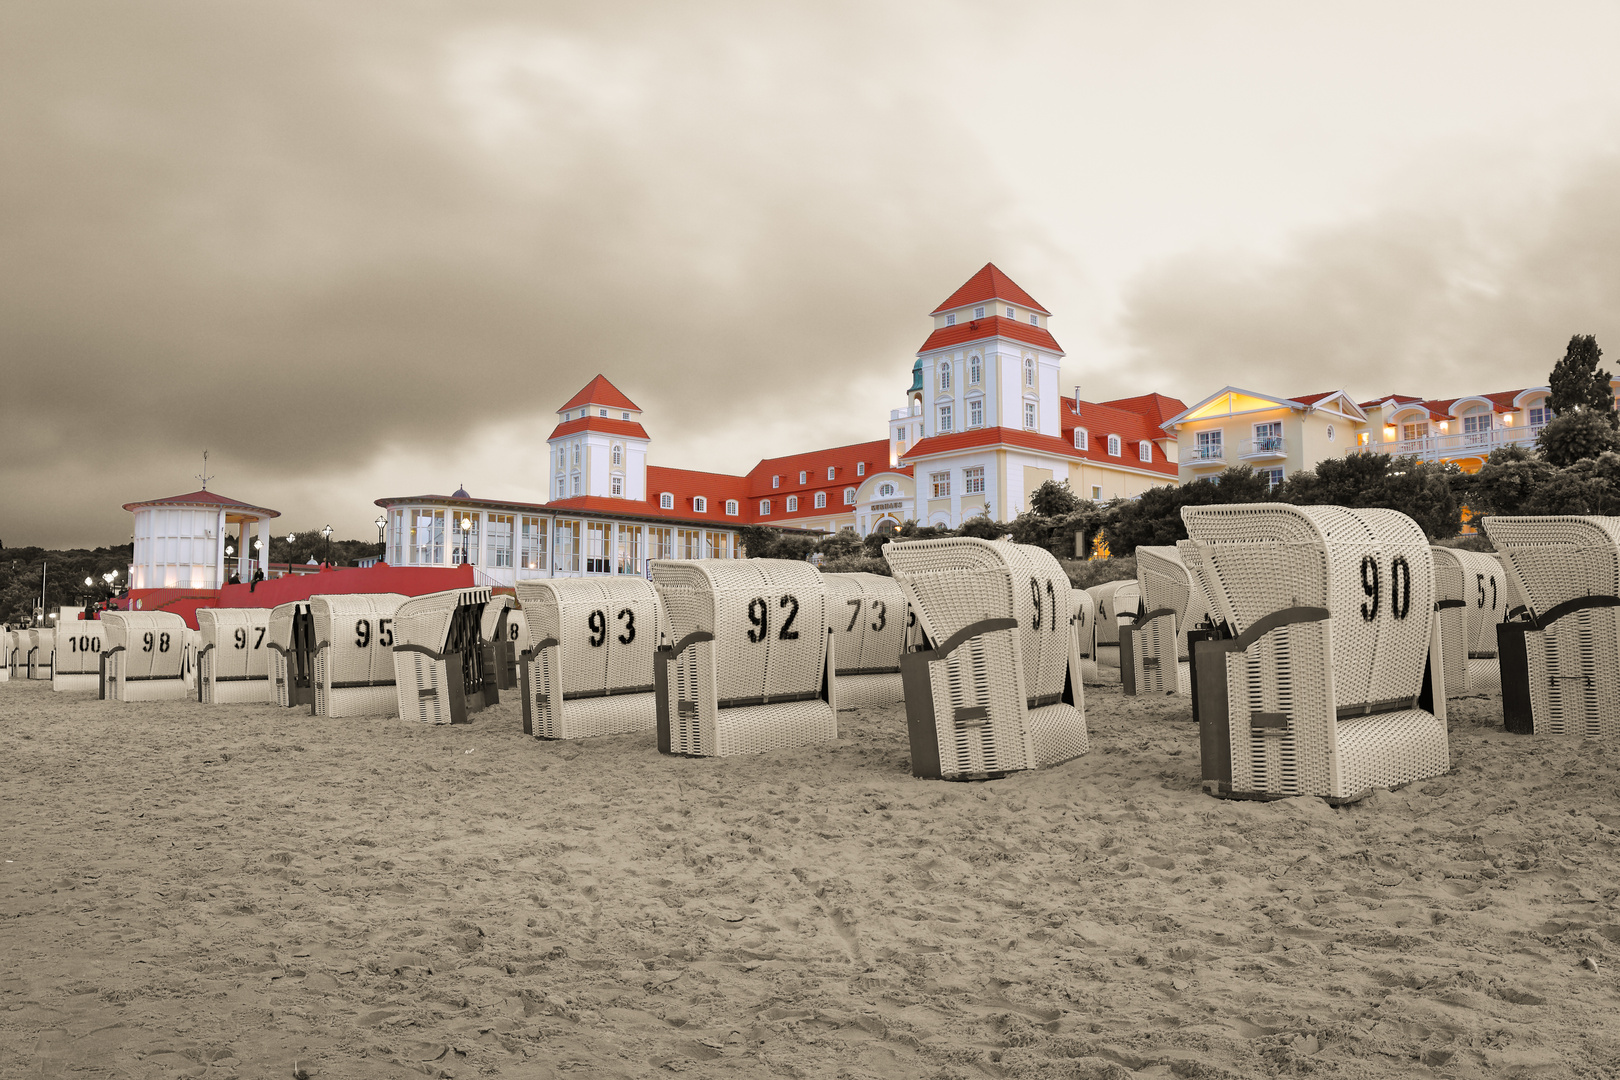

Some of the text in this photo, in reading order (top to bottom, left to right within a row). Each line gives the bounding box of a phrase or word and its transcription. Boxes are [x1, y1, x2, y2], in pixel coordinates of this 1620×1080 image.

[1030, 577, 1056, 632] 91
[1360, 555, 1411, 622] 90
[1477, 573, 1497, 610] 51
[510, 622, 519, 641] 8
[588, 608, 636, 647] 93
[747, 594, 799, 643] 92
[846, 600, 886, 632] 73
[69, 635, 101, 653] 100
[142, 631, 171, 653] 98
[234, 627, 266, 649] 97
[354, 618, 394, 648] 95
